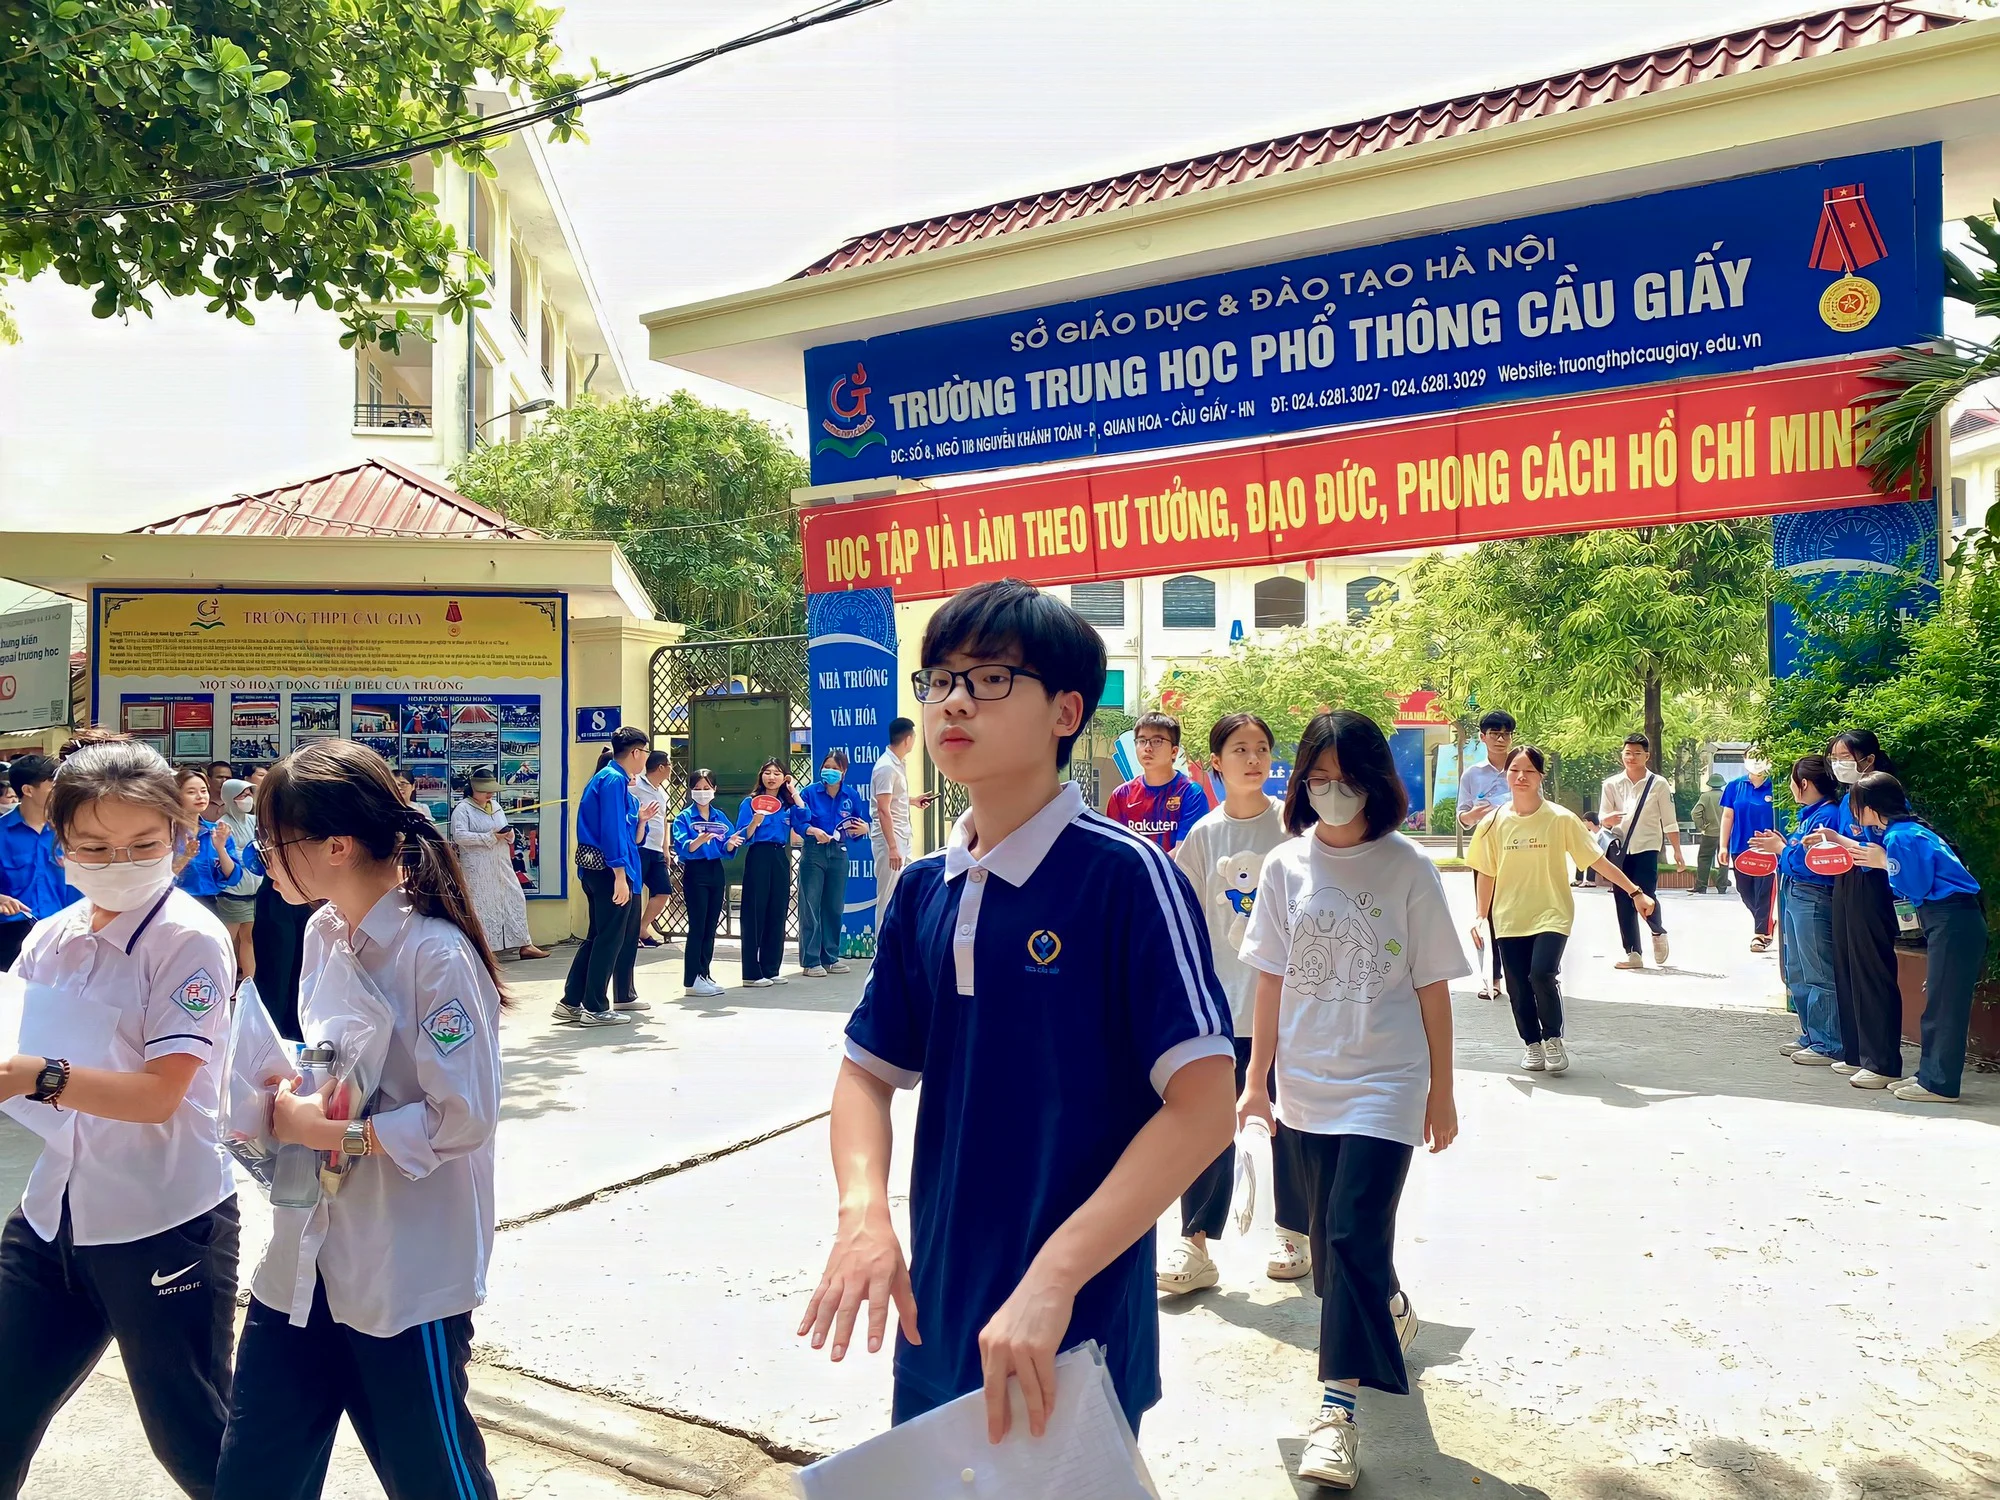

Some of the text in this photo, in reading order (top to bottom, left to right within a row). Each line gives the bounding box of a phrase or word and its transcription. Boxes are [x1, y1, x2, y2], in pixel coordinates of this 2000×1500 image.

[1010, 233, 1555, 352] SỞ GIÁO DỤC & ĐÀO TẠO HÀ NỘI
[888, 374, 1016, 431] TRƯỜNG
[1025, 355, 1147, 411] TRUNG
[1159, 340, 1238, 397] HỌC
[1250, 302, 1337, 378] PHỔ
[1349, 297, 1501, 362] THÔNG
[1517, 263, 1616, 338] CẦU
[1633, 240, 1752, 322] GIẤY
[890, 448, 908, 464] ĐC:
[908, 438, 923, 461] SỐ
[961, 438, 976, 454] 118
[976, 426, 1016, 452] NGUYỄN
[1017, 425, 1052, 448] KHÁNH
[1053, 421, 1082, 442] TOÀN
[1103, 416, 1135, 437] QUAN
[1138, 412, 1162, 432] HOA
[1171, 402, 1196, 427] CẦU
[1199, 396, 1228, 423] GIẤY
[1238, 400, 1255, 418] HN
[1271, 395, 1289, 414] ĐT:
[1291, 382, 1381, 411] 024.6281.3027
[1391, 368, 1487, 398] 024.6281.3029
[1498, 359, 1557, 383] Website:
[826, 534, 871, 590] HỌC
[876, 520, 920, 585] TẬP
[925, 513, 959, 570] VÀ
[963, 508, 1017, 566] LÀM
[1022, 504, 1088, 558] THEO
[1093, 494, 1129, 550] TƯ
[1134, 475, 1239, 546] TƯỞNG,
[1246, 476, 1307, 543] ĐẠO
[1314, 458, 1388, 525] ĐỨC,
[1396, 449, 1510, 516] PHONG
[1521, 430, 1616, 502] CÁCH
[1628, 408, 1678, 490] HỒ
[1691, 405, 1757, 484] CHÍ
[310, 611, 348, 625] THPT
[818, 665, 889, 690] NHÀ TRƯỜNG
[591, 710, 607, 731] 8
[830, 703, 877, 727] VĂN HÓA
[1128, 818, 1178, 832] Rakuten
[158, 1286, 178, 1296] JUST
[179, 1283, 192, 1292] DO
